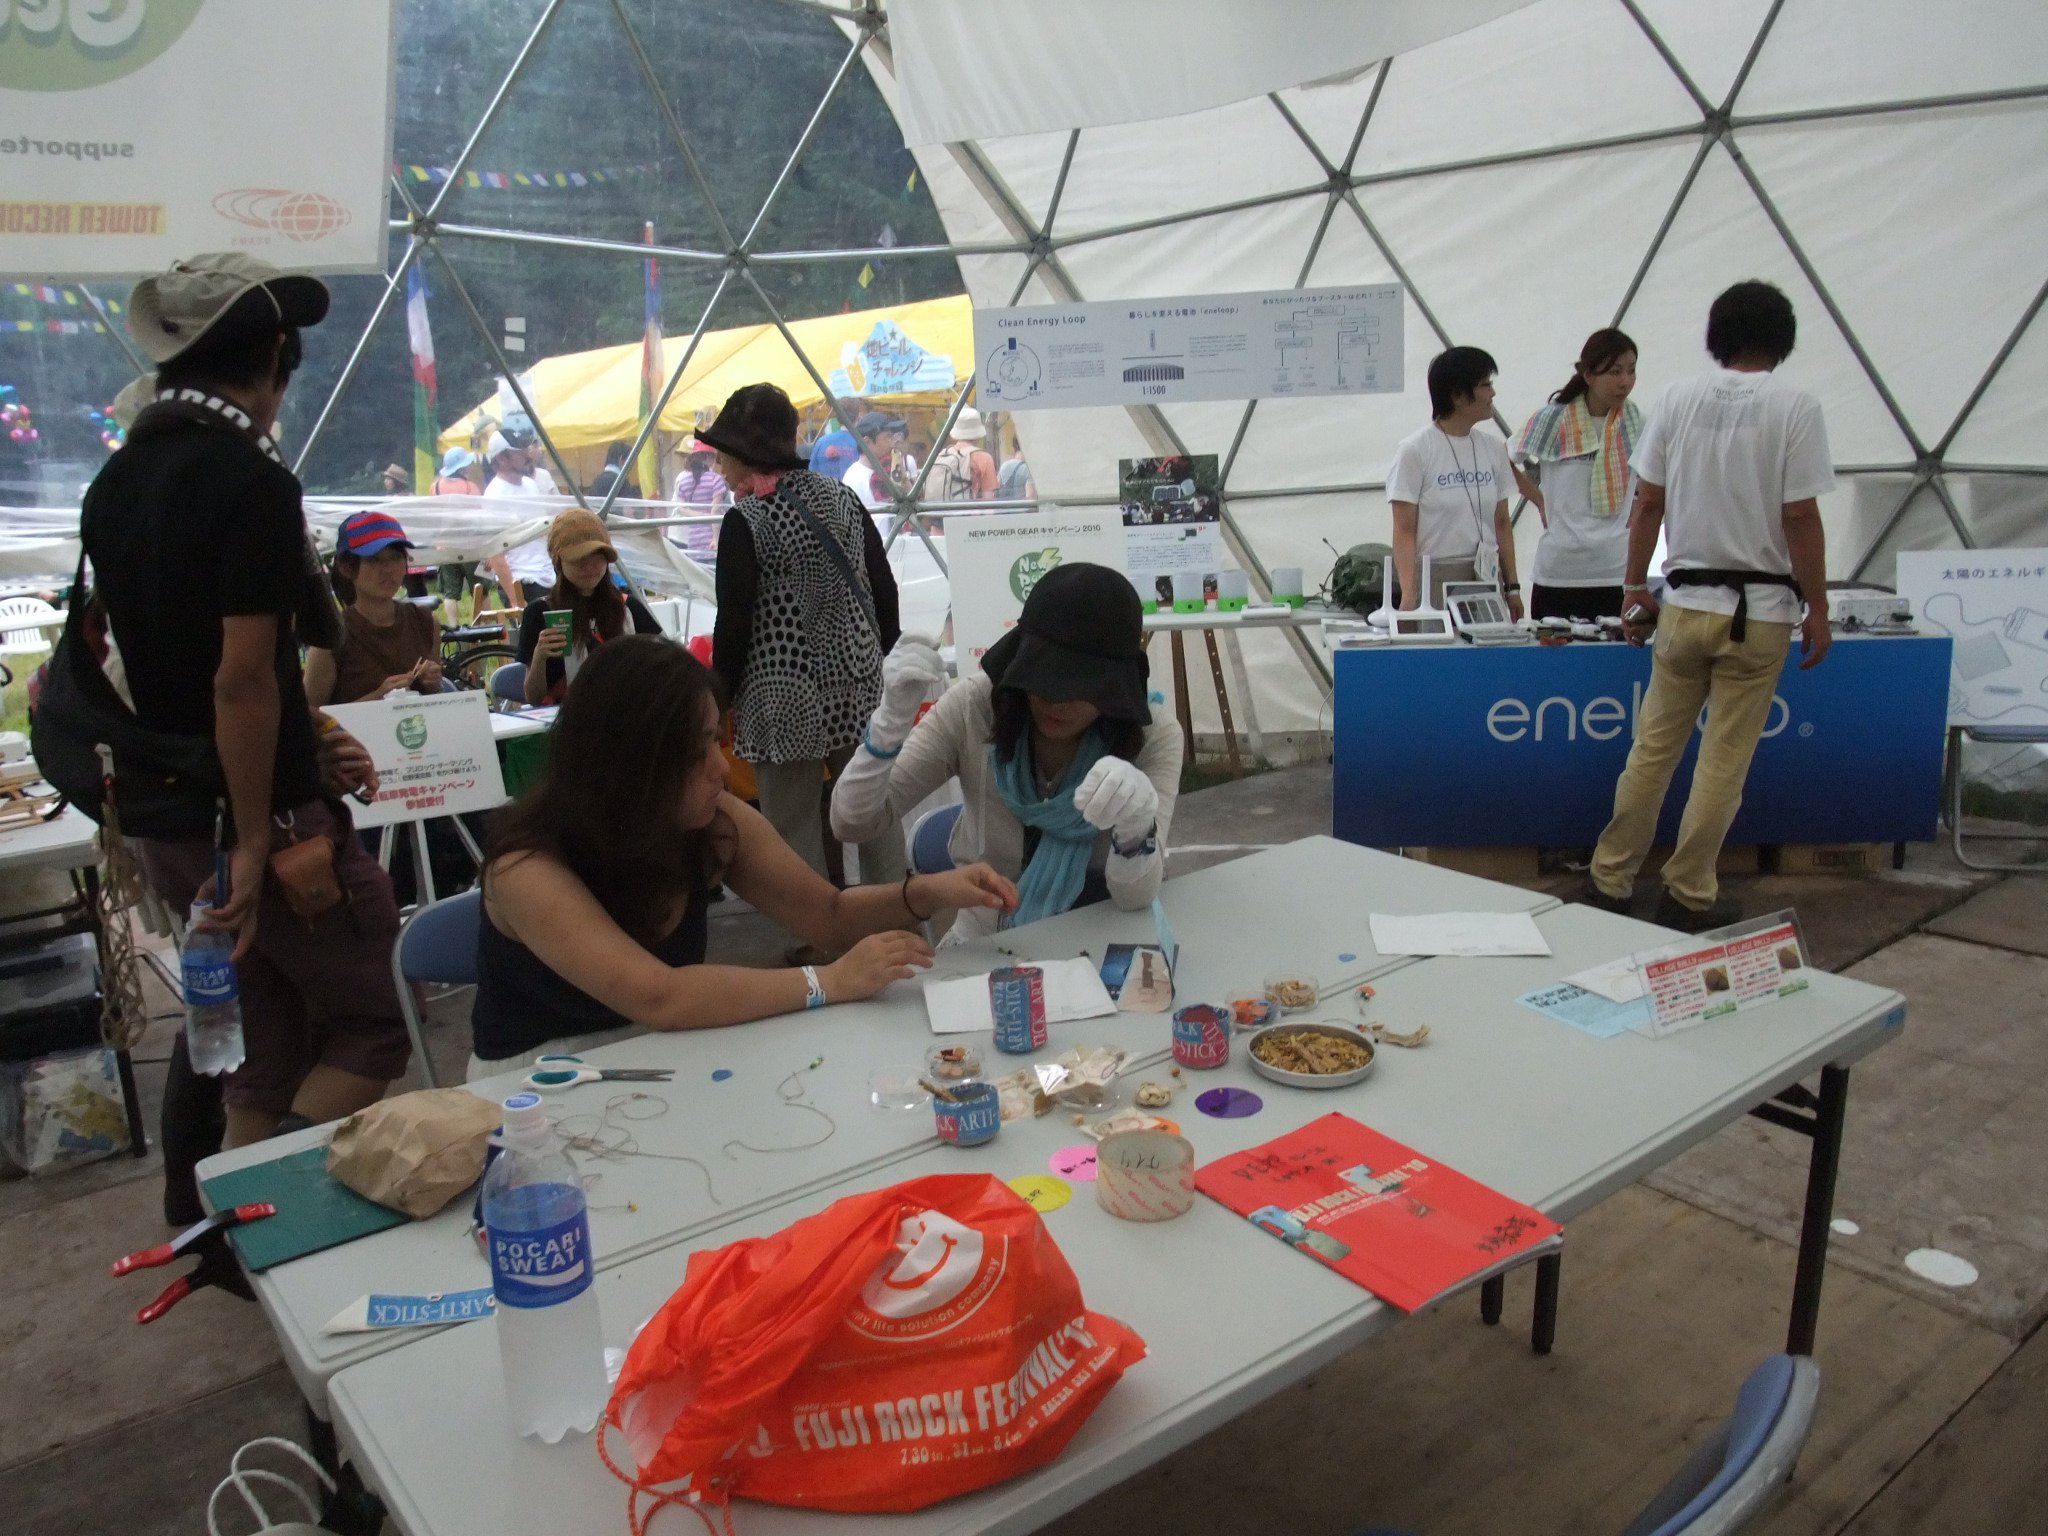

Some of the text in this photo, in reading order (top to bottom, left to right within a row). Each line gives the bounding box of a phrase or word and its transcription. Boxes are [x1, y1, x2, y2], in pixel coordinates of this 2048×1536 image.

[998, 315, 1086, 328] Clean Energy Loop
[1142, 384, 1166, 395] 1:1500
[969, 530, 986, 538] NEW
[988, 529, 1016, 537] POWER
[1017, 527, 1039, 536] GEAR
[1082, 524, 1101, 533] 2010
[496, 1227, 581, 1258] POCARI
[498, 1245, 576, 1274] SWEAT
[900, 1308, 956, 1333] solution
[957, 1256, 1001, 1311] company
[375, 1298, 486, 1324] ARTI-STICK
[793, 1404, 872, 1452] FUJI
[873, 1389, 970, 1442] ROCK
